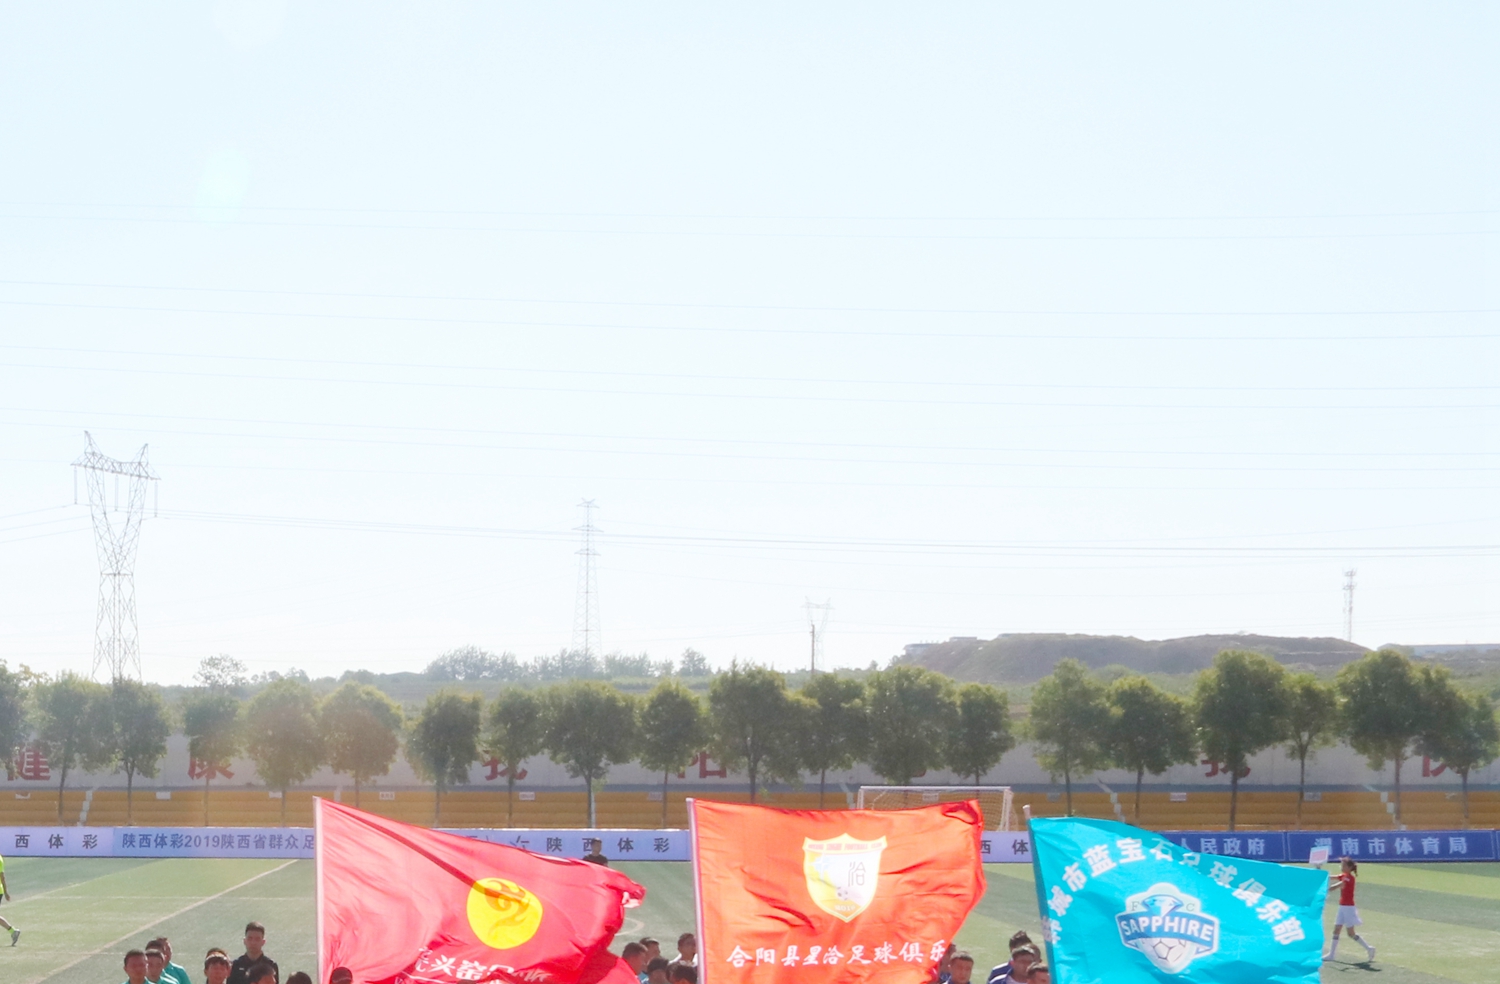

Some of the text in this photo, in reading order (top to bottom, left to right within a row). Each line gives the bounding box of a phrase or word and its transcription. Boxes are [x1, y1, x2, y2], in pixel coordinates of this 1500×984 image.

[122, 833, 314, 849] 陕西体彩2019陕西省群众足
[1314, 838, 1468, 854] 渭南市体育局
[1121, 915, 1214, 942] SAPPHIRE
